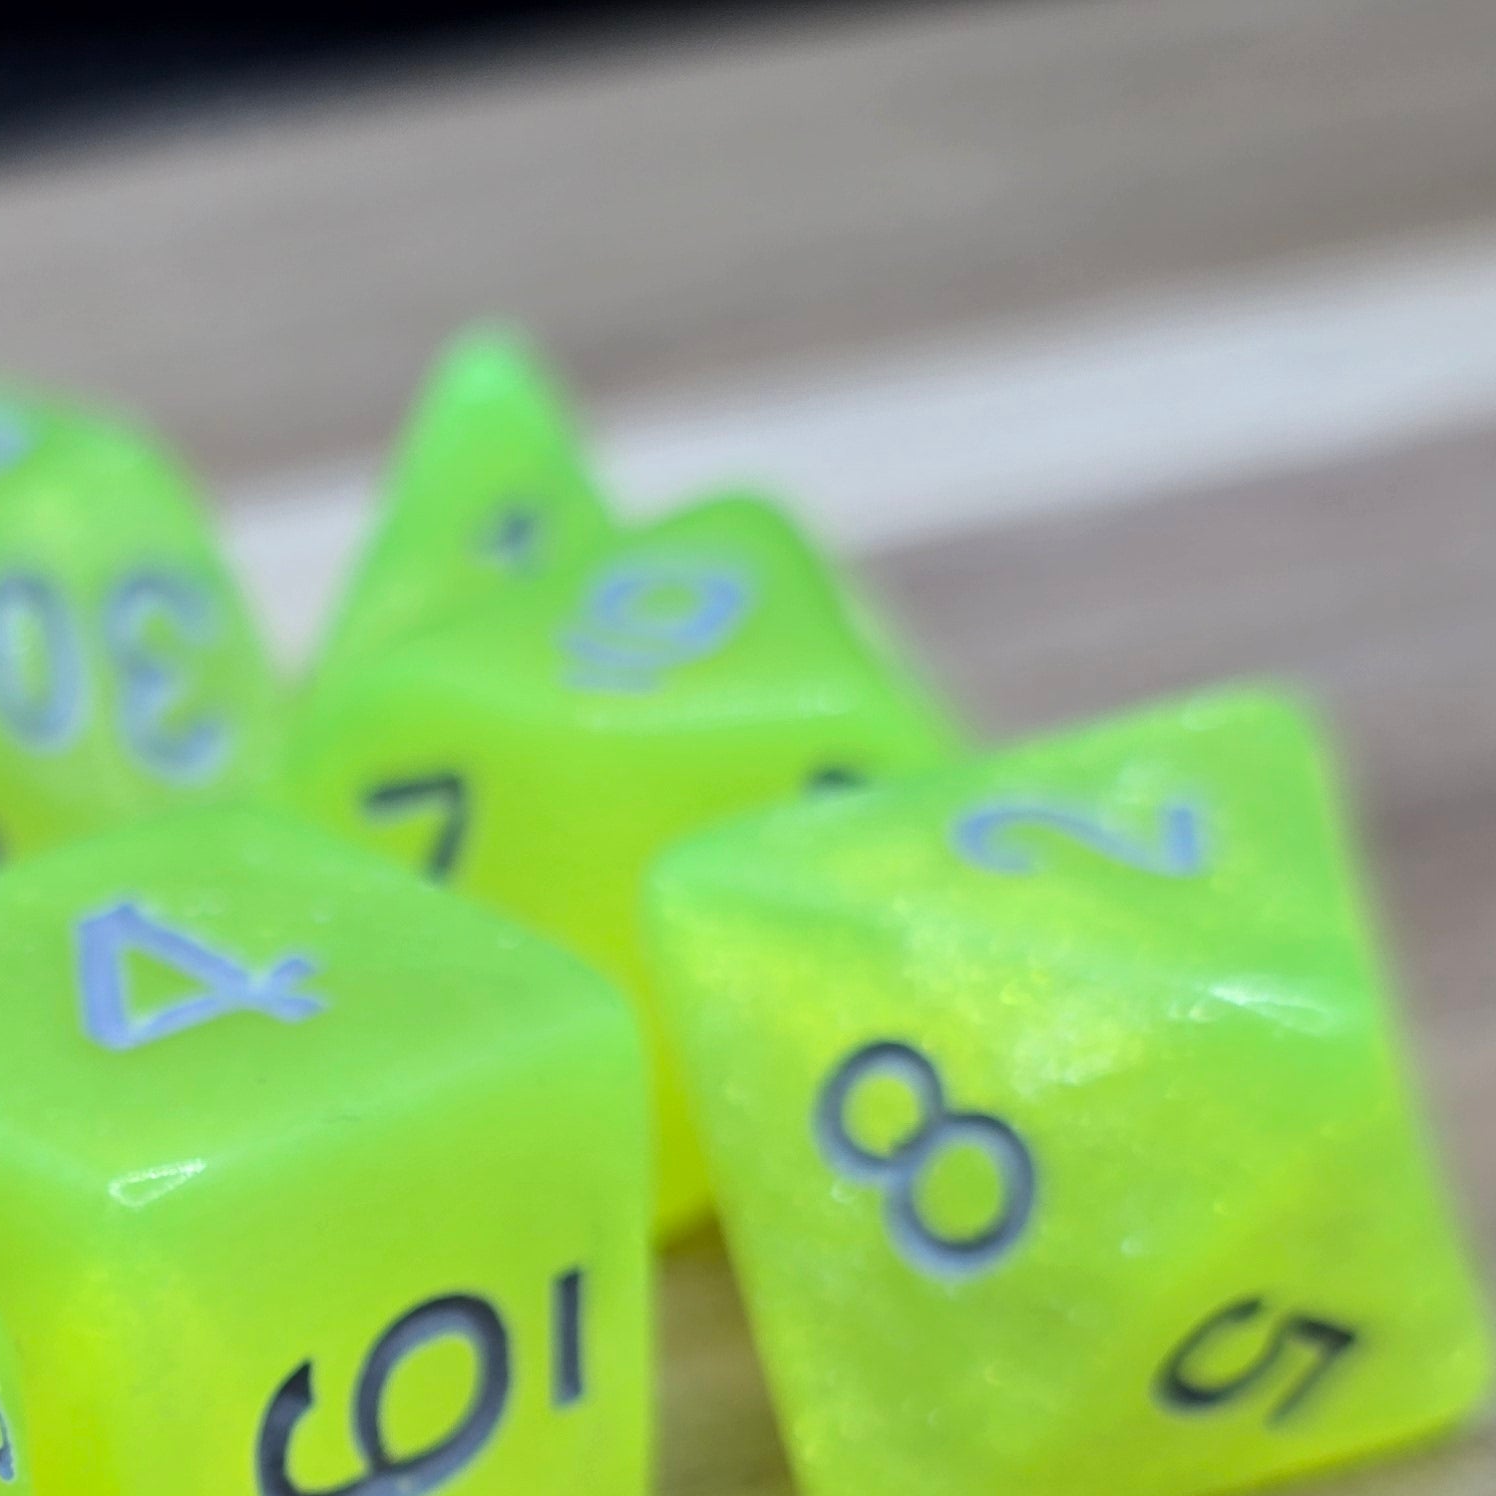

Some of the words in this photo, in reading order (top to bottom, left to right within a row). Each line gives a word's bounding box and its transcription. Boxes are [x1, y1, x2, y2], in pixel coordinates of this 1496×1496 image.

[949, 796, 1210, 880] 2
[72, 892, 332, 1054] 4
[814, 1036, 1035, 1284] 8
[1152, 1294, 1360, 1430] 5
